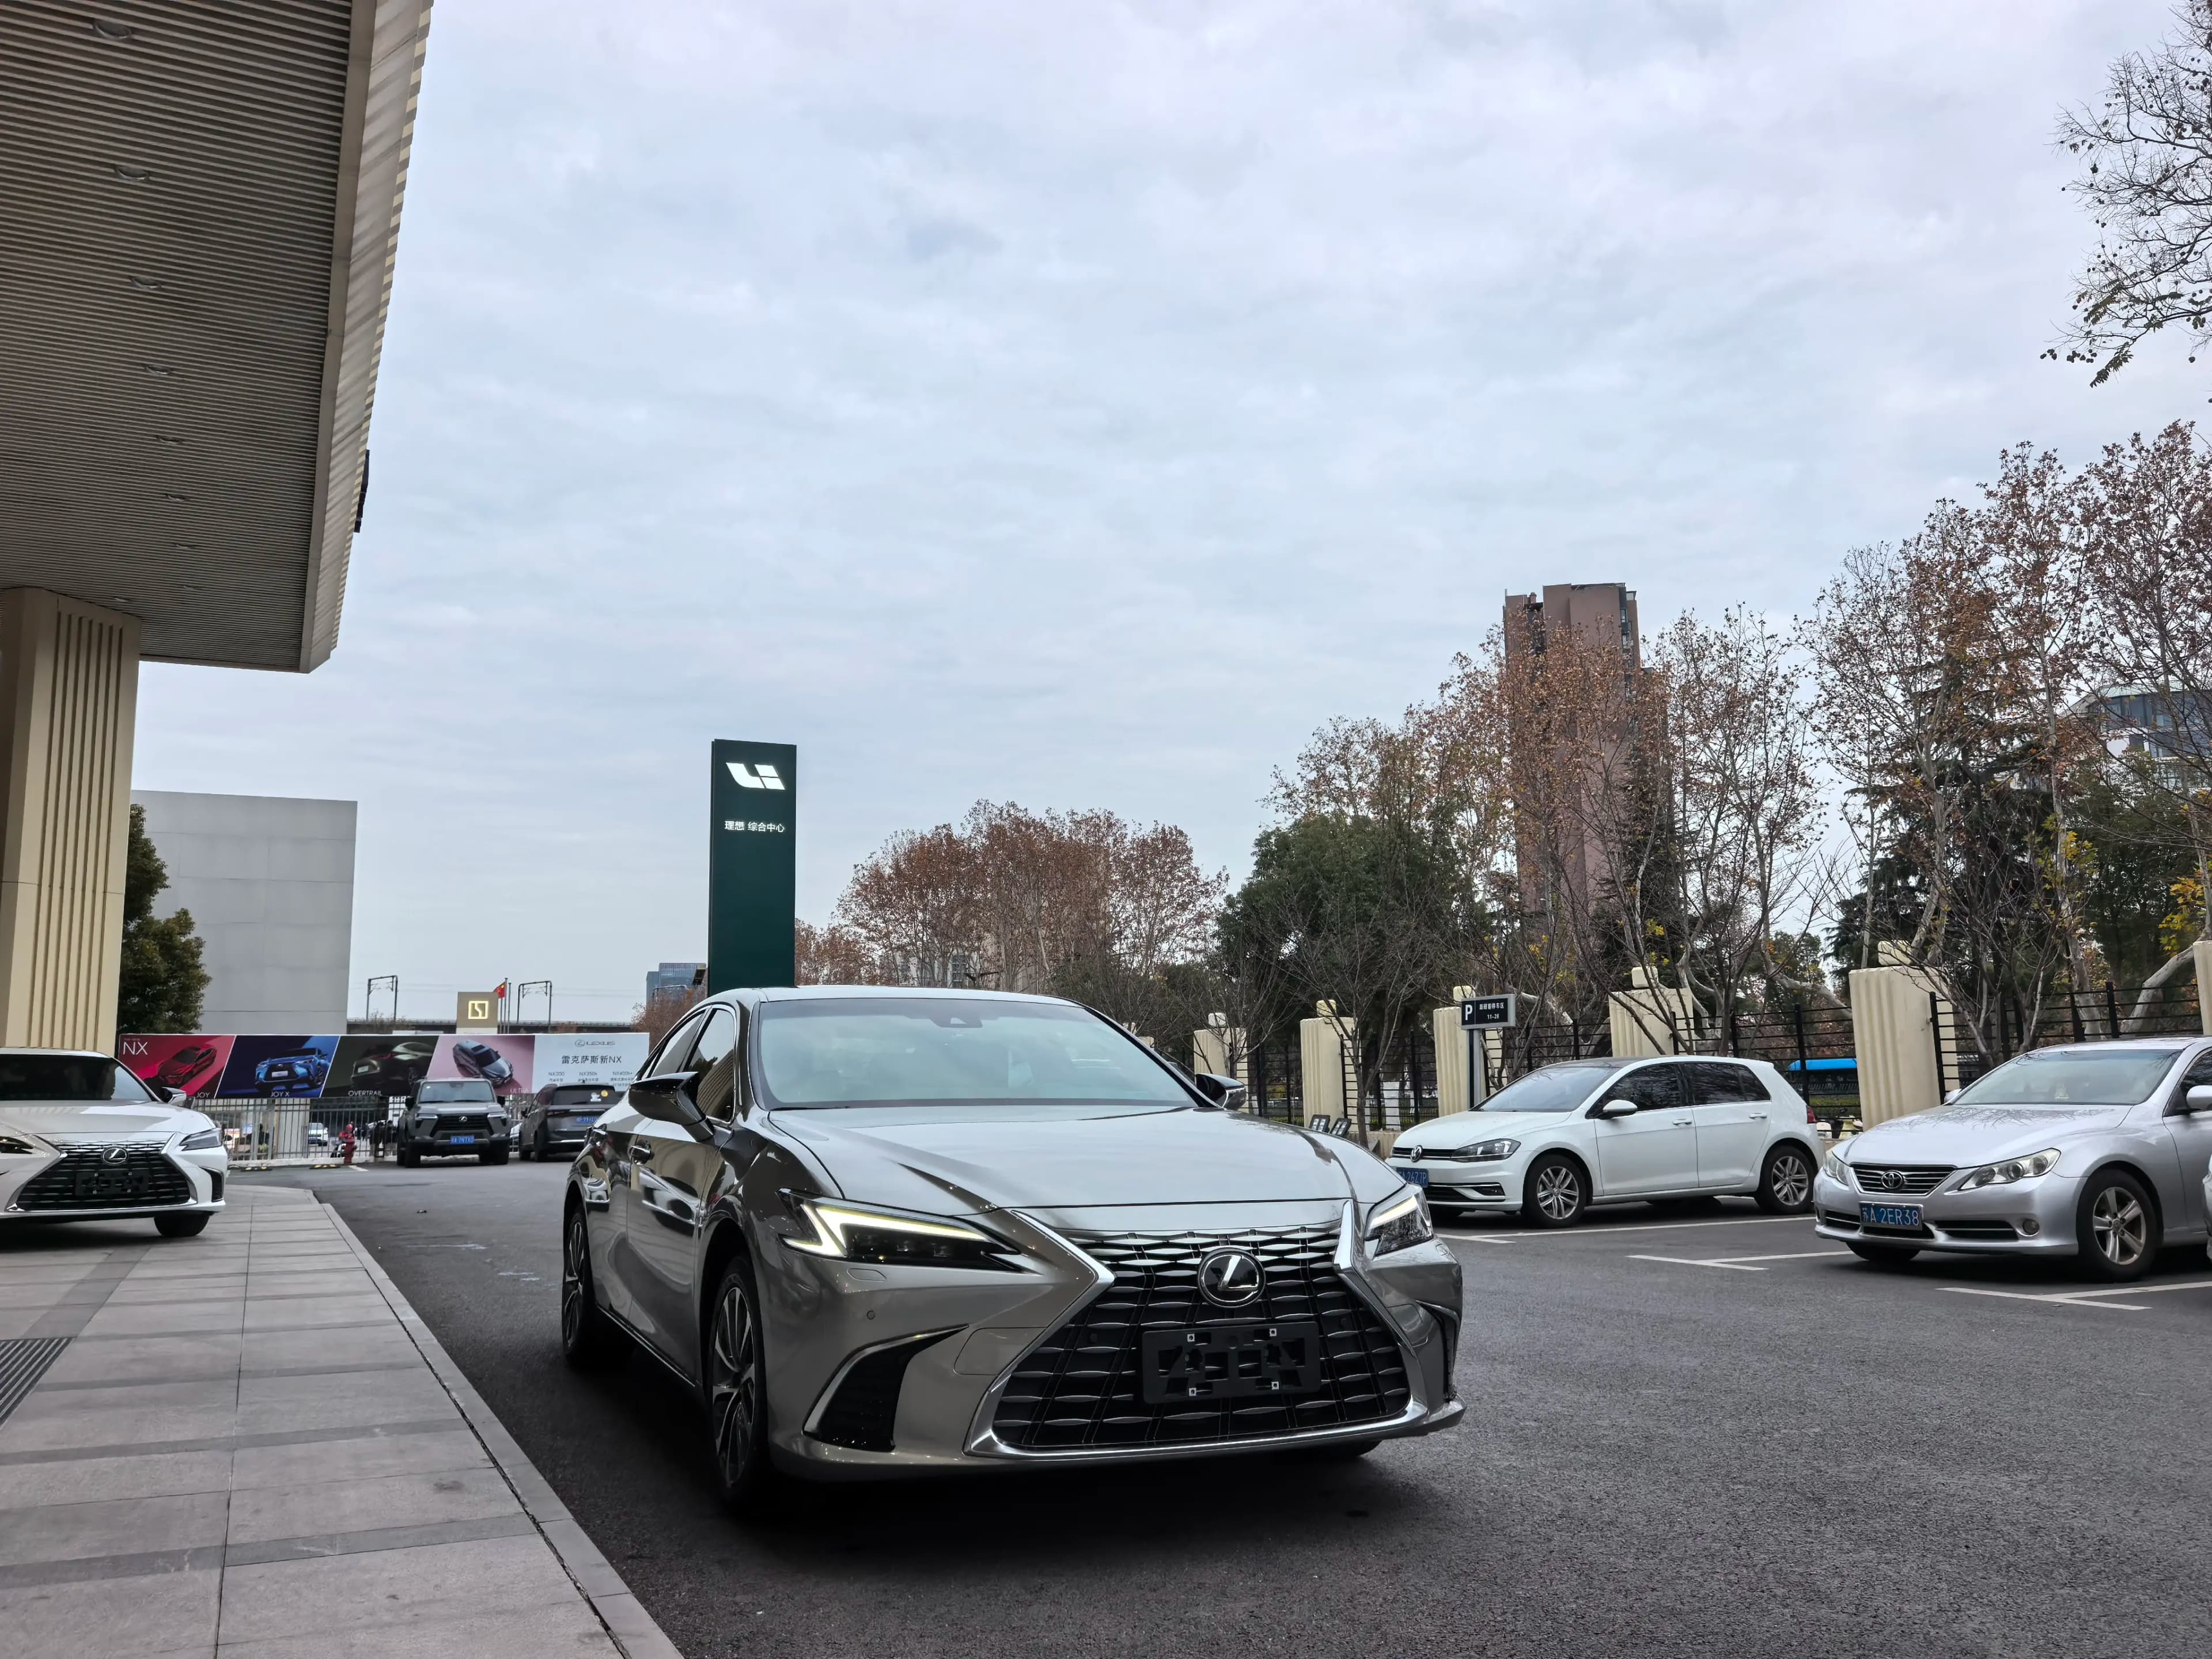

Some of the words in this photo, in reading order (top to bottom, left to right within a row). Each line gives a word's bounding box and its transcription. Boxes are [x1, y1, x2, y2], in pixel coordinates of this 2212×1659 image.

[725, 820, 744, 831] 理想
[748, 822, 785, 833] 综合中心
[1465, 1005, 1473, 1020] P
[123, 1041, 148, 1055] NX
